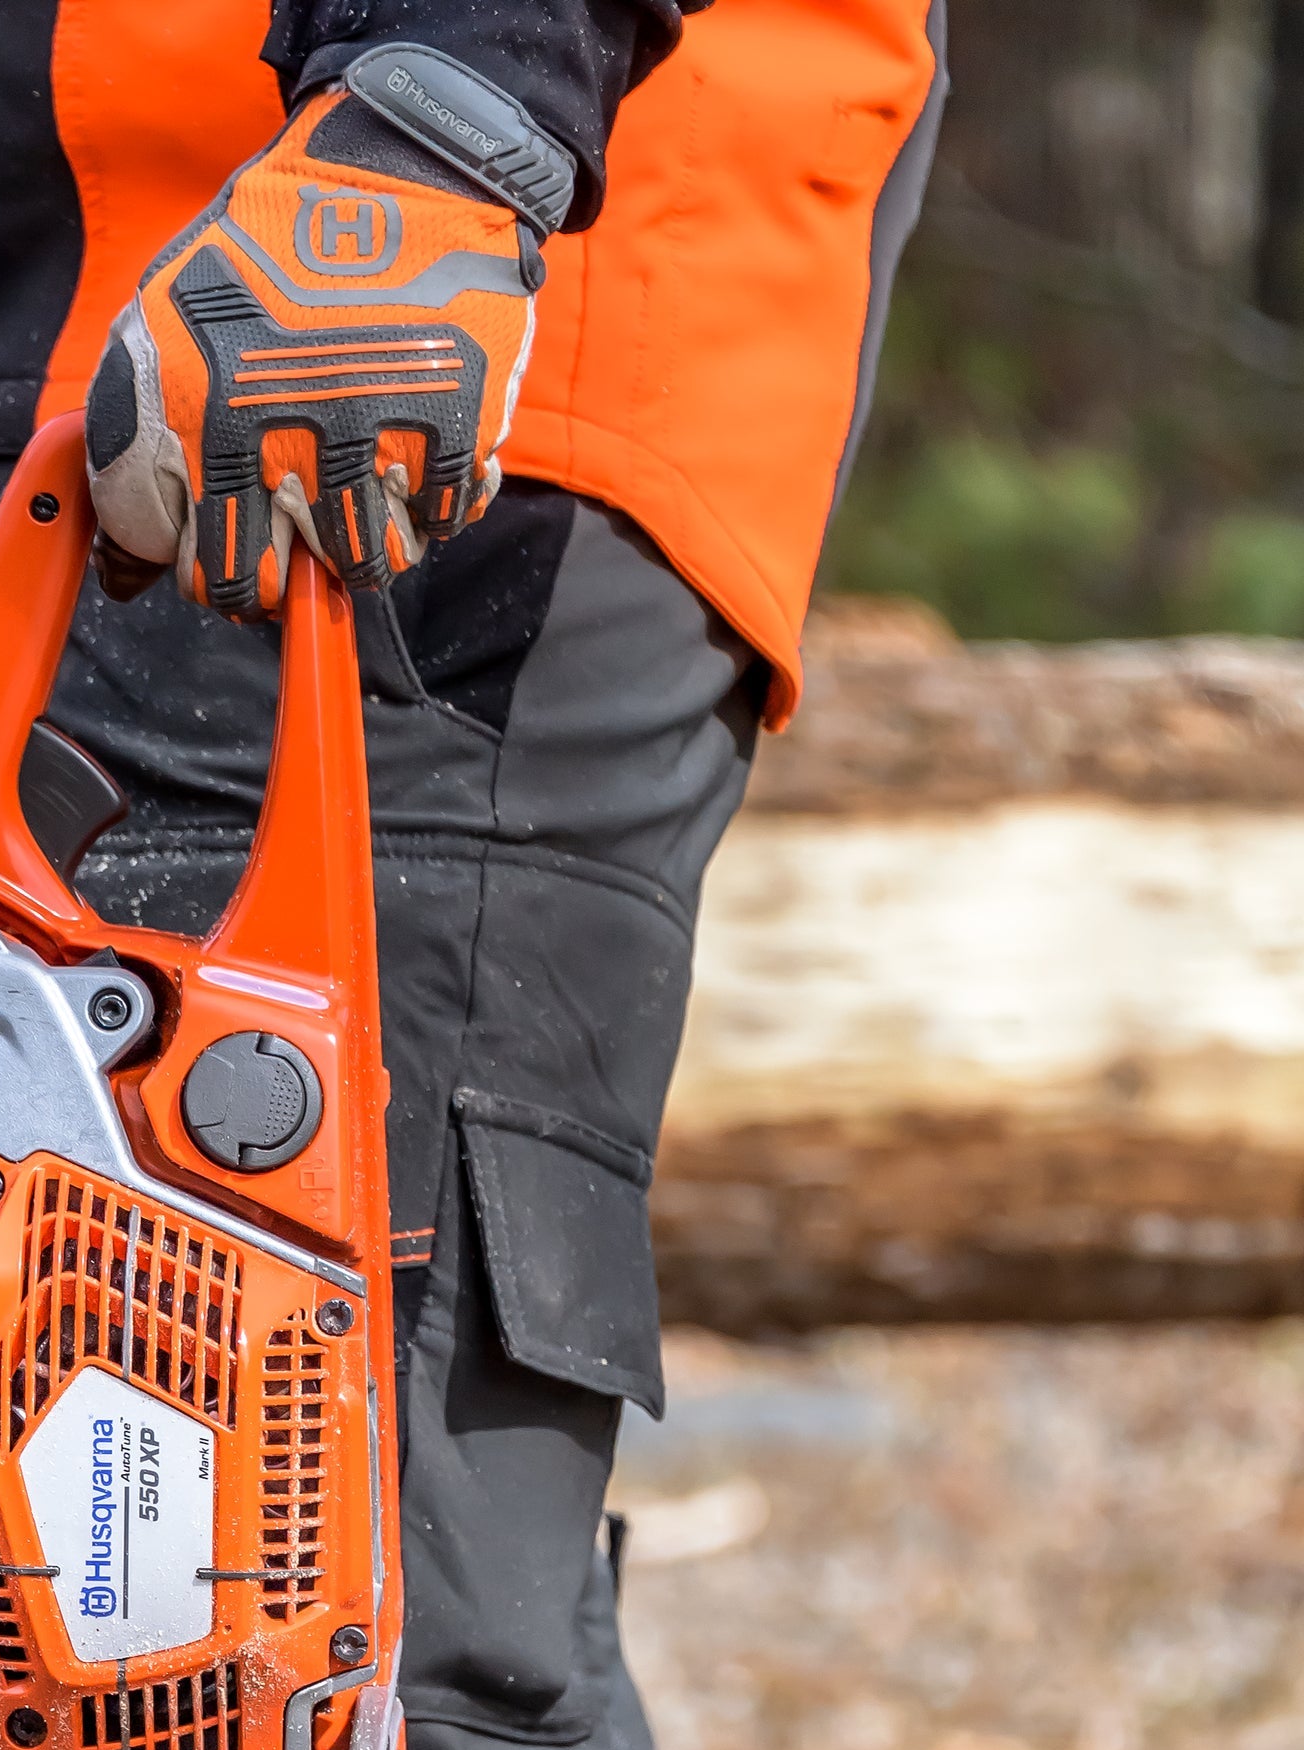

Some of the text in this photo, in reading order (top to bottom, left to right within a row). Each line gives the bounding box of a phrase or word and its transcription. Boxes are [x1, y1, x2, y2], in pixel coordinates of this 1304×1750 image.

[404, 79, 497, 154] Husqvarna
[85, 1418, 118, 1582] Husqvarna
[138, 1427, 161, 1523] 550 XP
[198, 1437, 210, 1480] Mark II
